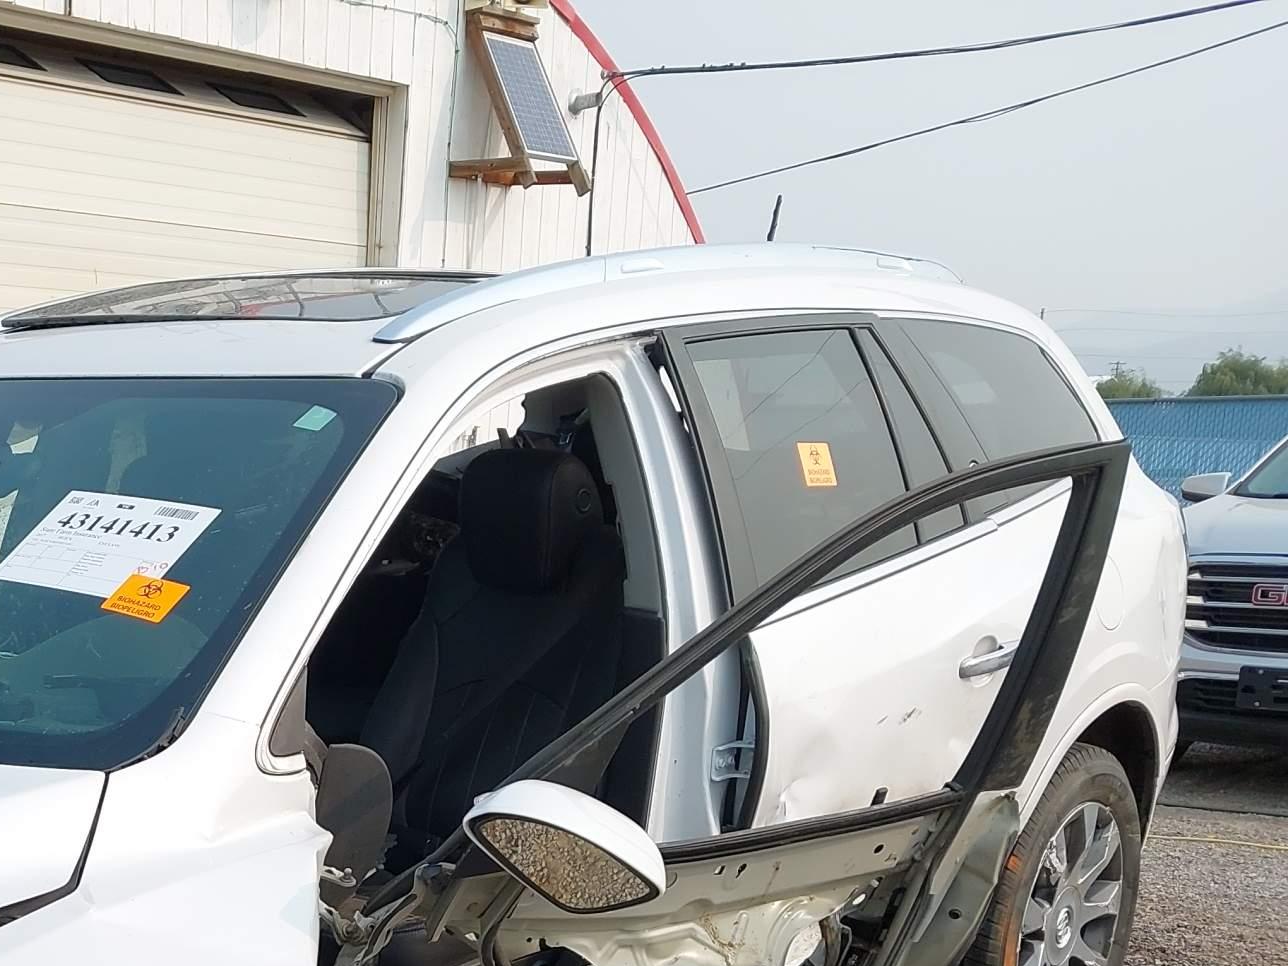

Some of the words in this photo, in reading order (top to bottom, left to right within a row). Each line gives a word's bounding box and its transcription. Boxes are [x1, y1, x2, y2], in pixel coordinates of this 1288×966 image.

[56, 511, 181, 543] 43141413
[117, 595, 162, 612] BIOHAZARD
[1251, 583, 1288, 605] G
[110, 602, 156, 619] BIOPELIGRO
